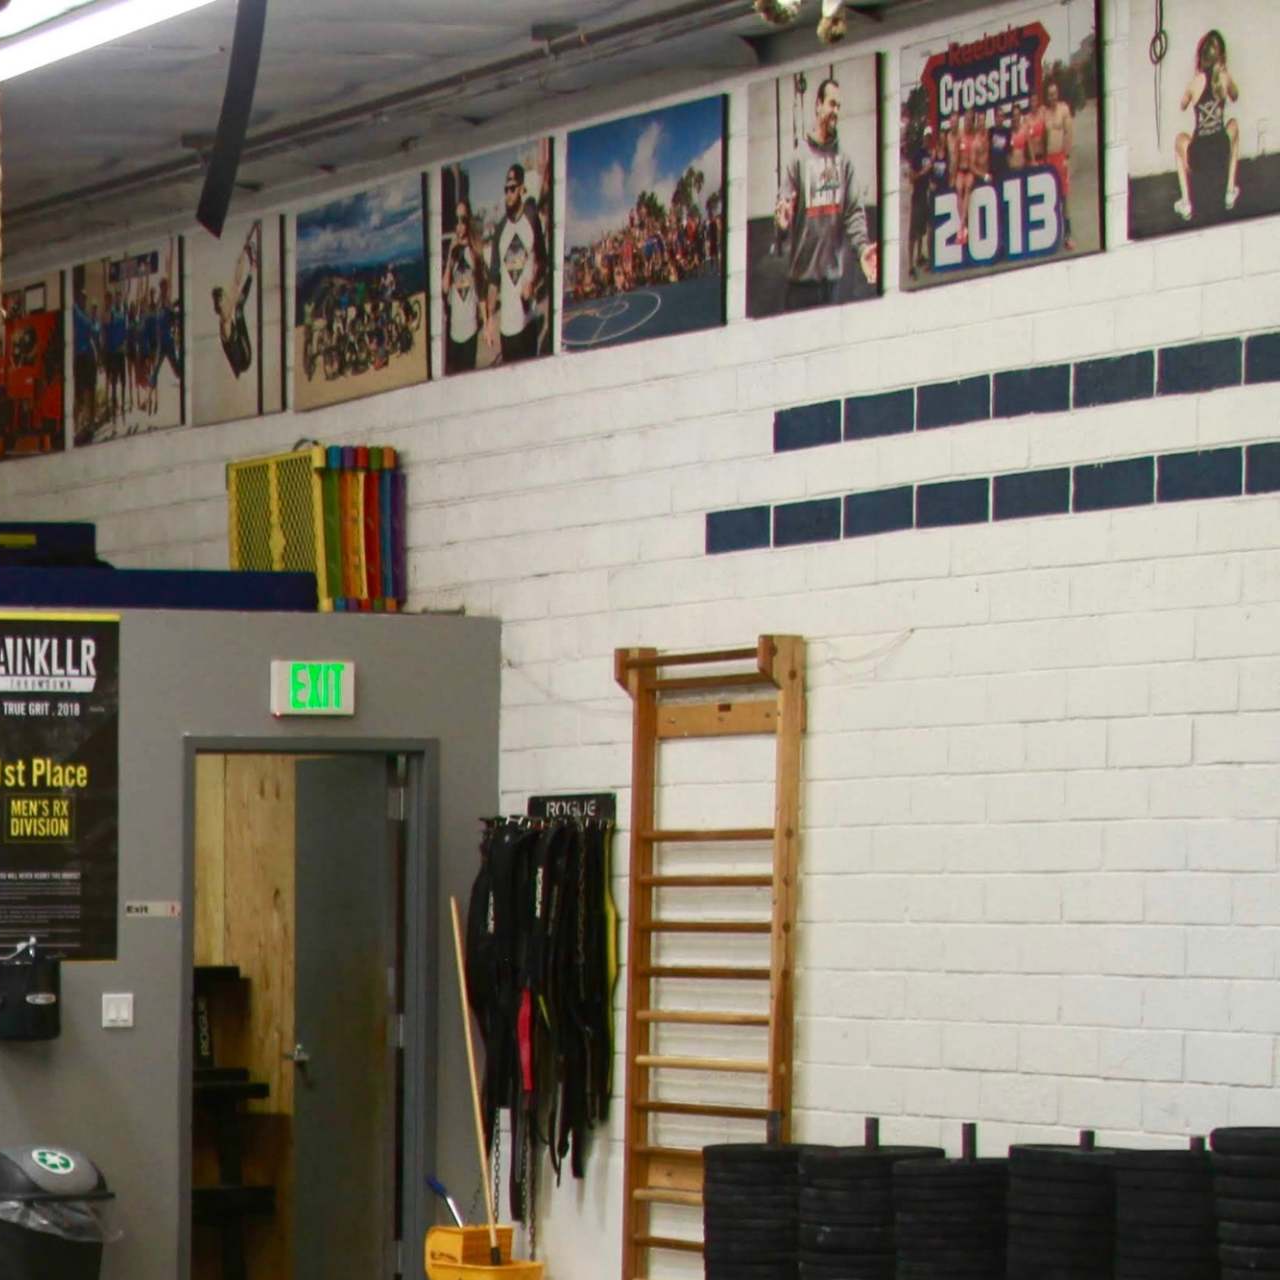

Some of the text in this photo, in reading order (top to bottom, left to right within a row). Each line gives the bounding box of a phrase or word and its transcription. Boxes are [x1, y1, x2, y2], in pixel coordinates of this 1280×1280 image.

[946, 24, 1022, 67] Reebok
[940, 54, 1030, 116] CrossFit
[934, 172, 1058, 268] 2013
[291, 663, 345, 709] EXIT
[3, 701, 27, 716] TRUE
[28, 702, 50, 716] GRIT
[57, 702, 80, 717] 2018
[32, 757, 88, 787] Place
[11, 800, 69, 817] MEN'S RX
[546, 800, 597, 816] ROGUE
[11, 818, 69, 836] DIVISION
[126, 904, 149, 914] Exit
